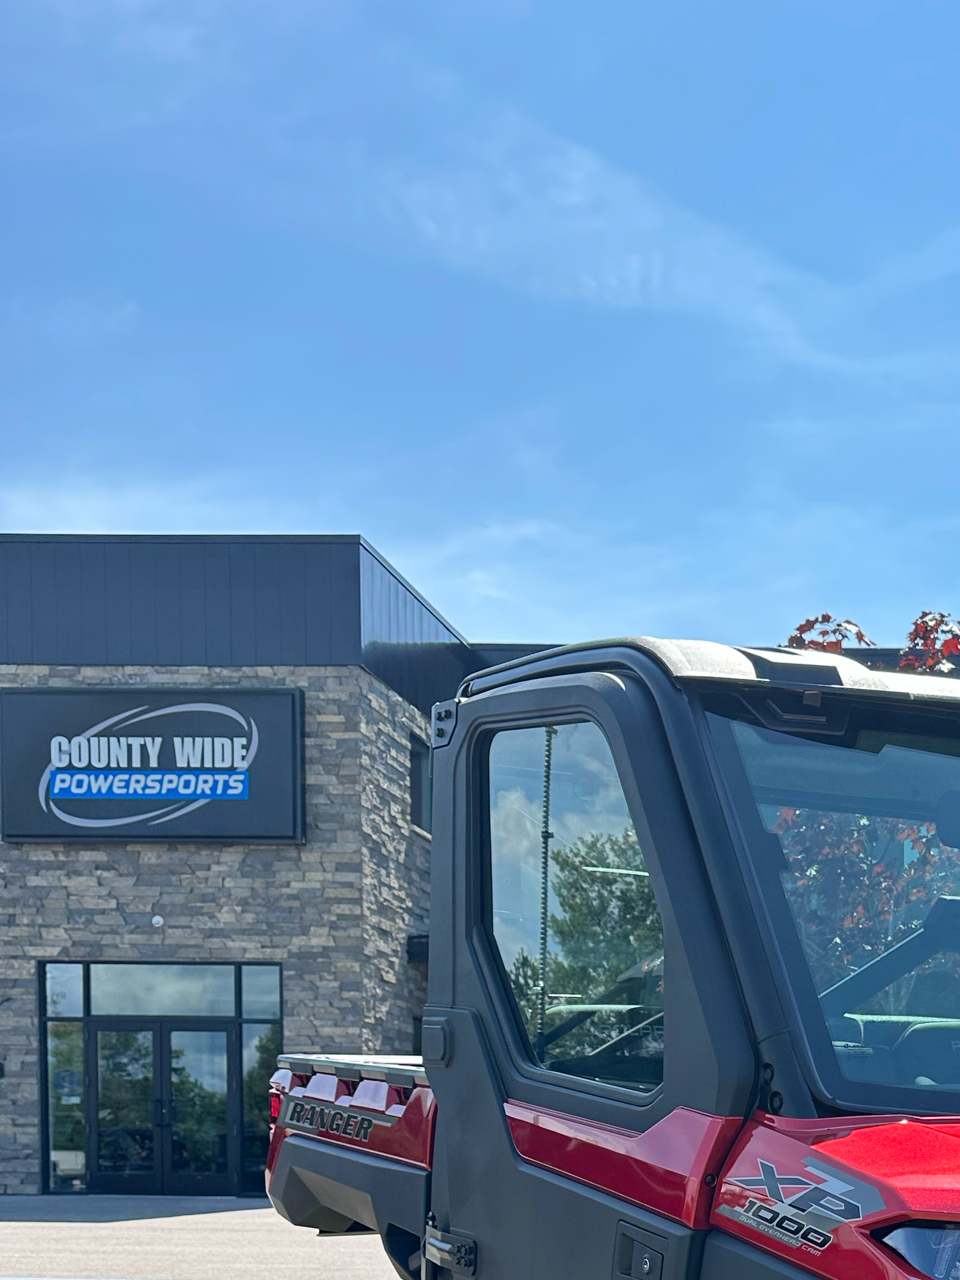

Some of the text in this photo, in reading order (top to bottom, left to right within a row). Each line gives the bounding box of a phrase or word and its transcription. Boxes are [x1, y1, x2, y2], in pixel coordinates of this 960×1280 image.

[50, 736, 248, 768] COUNTY WIDE
[53, 773, 245, 795] POWERSPORTS
[288, 1099, 373, 1142] RANGER
[723, 1157, 863, 1222] XP
[738, 1215, 822, 1257] DUAL OVERHEAD CAM
[743, 1197, 834, 1251] 1000
